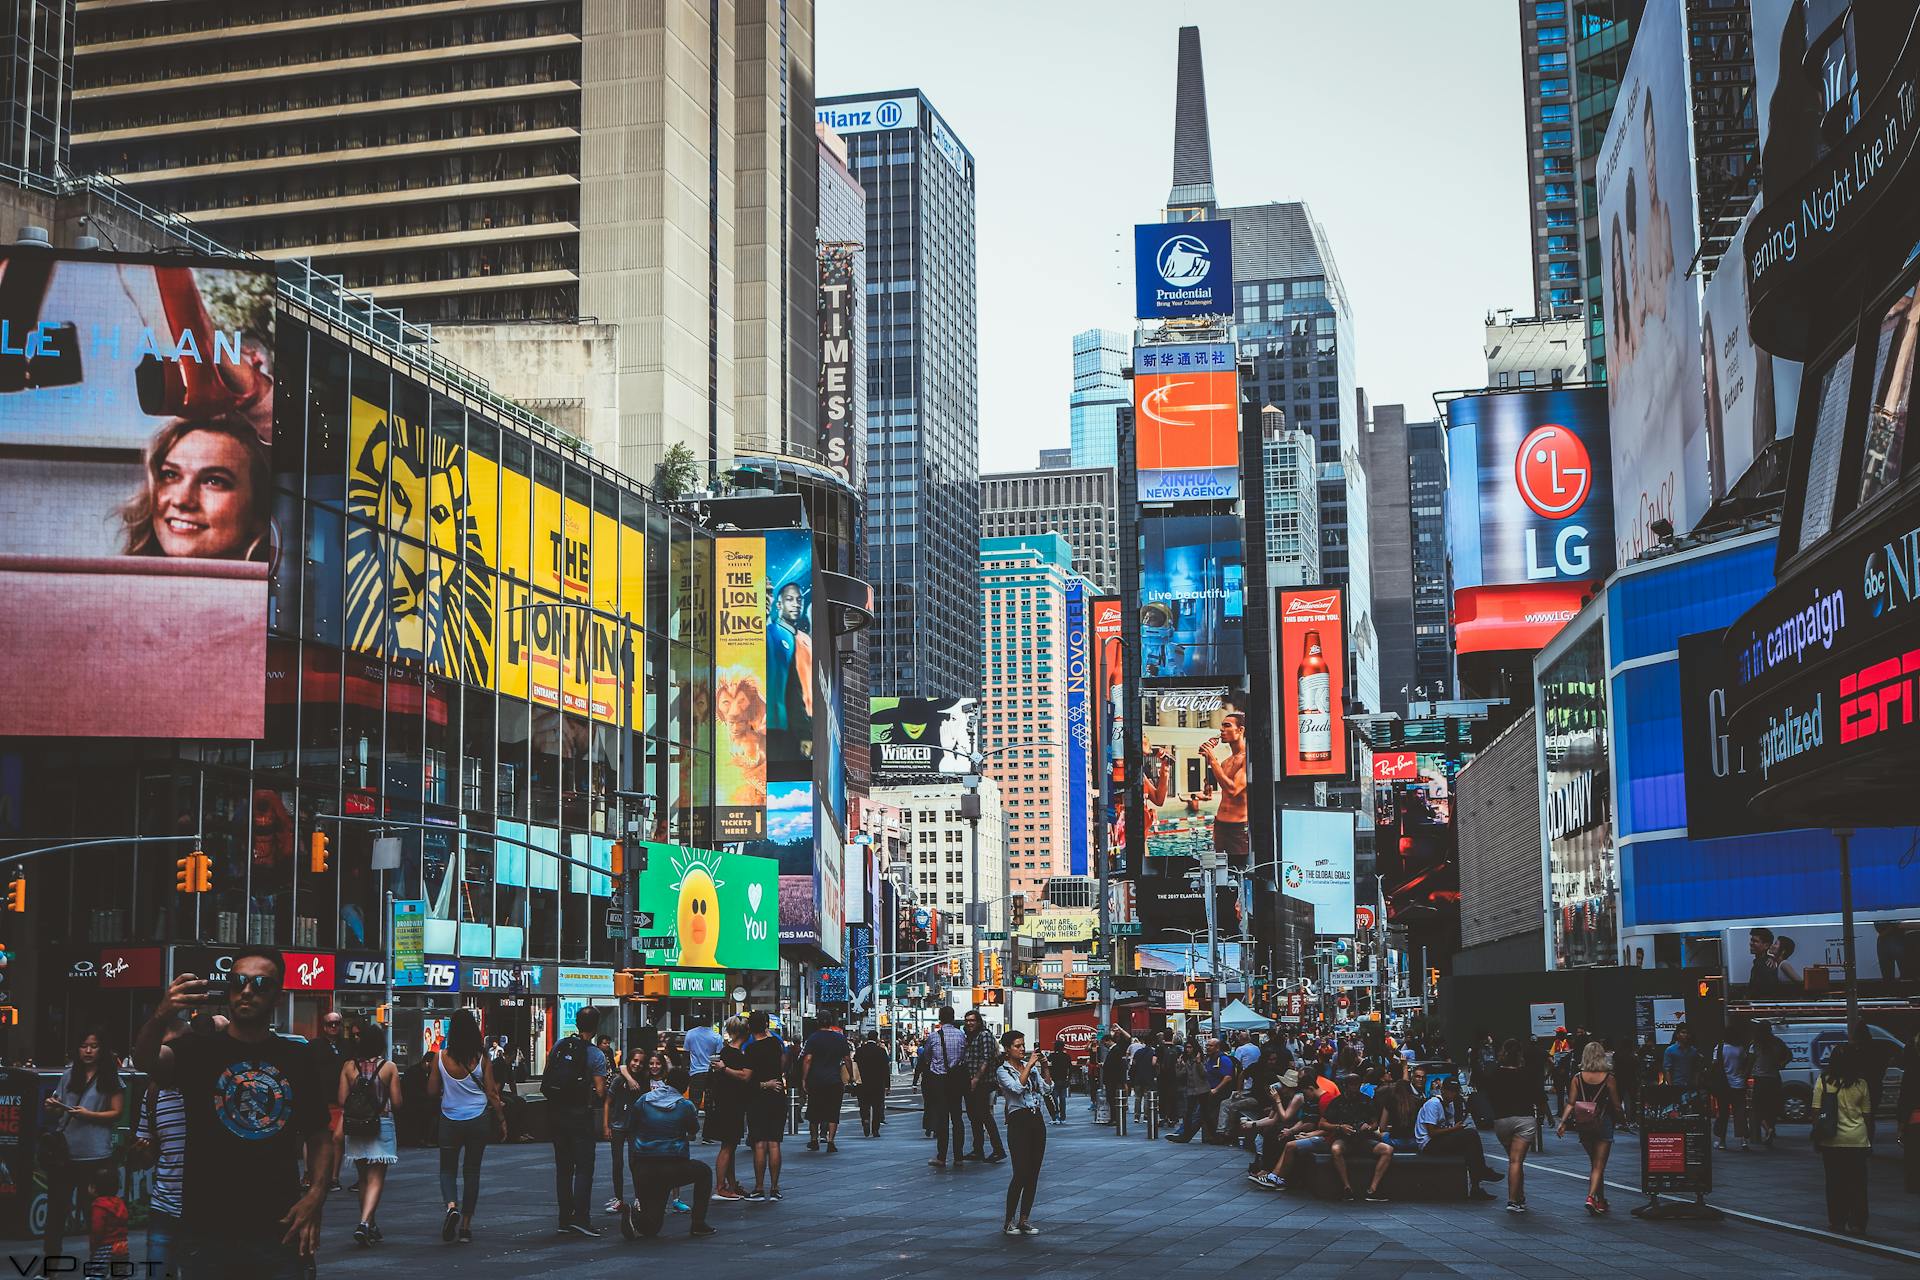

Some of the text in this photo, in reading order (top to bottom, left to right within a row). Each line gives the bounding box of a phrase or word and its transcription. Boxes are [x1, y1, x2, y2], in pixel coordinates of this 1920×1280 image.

[817, 109, 871, 129] llianz
[1752, 218, 1797, 284] ening
[1801, 170, 1853, 239] Night
[1854, 137, 1884, 193] Live
[1885, 113, 1899, 155] in
[1156, 287, 1213, 300] Prudential
[91, 323, 243, 366] HAAN
[822, 284, 850, 421] TIMES
[1143, 350, 1226, 367] 新华通讯社
[1146, 485, 1232, 498] NEWS AGENCY
[1159, 473, 1218, 488] XINHUA
[549, 530, 590, 583] THE
[1525, 525, 1591, 580] LG
[726, 572, 752, 585] THE
[1864, 569, 1886, 601] abc
[722, 587, 758, 608] LION
[1148, 588, 1231, 601] Live beautiful
[508, 567, 571, 666] LION
[1289, 601, 1331, 611] Budweiser
[719, 610, 763, 636] KING
[1297, 615, 1315, 623] BUD'S
[1314, 614, 1326, 622] FOR
[1326, 613, 1340, 621] YOU.
[1766, 587, 1846, 668] campaign
[1067, 600, 1085, 693] NOVOTEL
[533, 685, 607, 716] ENTRANCE ON 45TH STREET
[1160, 690, 1224, 713] Coca-Cola
[1840, 647, 1920, 745] ESP
[1374, 754, 1414, 776] Ray-Ban
[1546, 769, 1592, 842] OLD NAVY
[720, 819, 752, 827] TICKETS
[1305, 870, 1351, 880] THE GLOBAL GOALS
[742, 914, 767, 941] YOU
[1057, 930, 1081, 938] THERE?
[1121, 925, 1132, 934] 44
[643, 938, 651, 948] W
[654, 938, 665, 948] 44
[102, 957, 130, 979] Ray-Ban
[209, 972, 228, 982] OAK
[297, 957, 325, 987] Ray-Ban
[344, 960, 457, 987] SKERS
[672, 978, 688, 991] NEW
[687, 978, 704, 992] YORK
